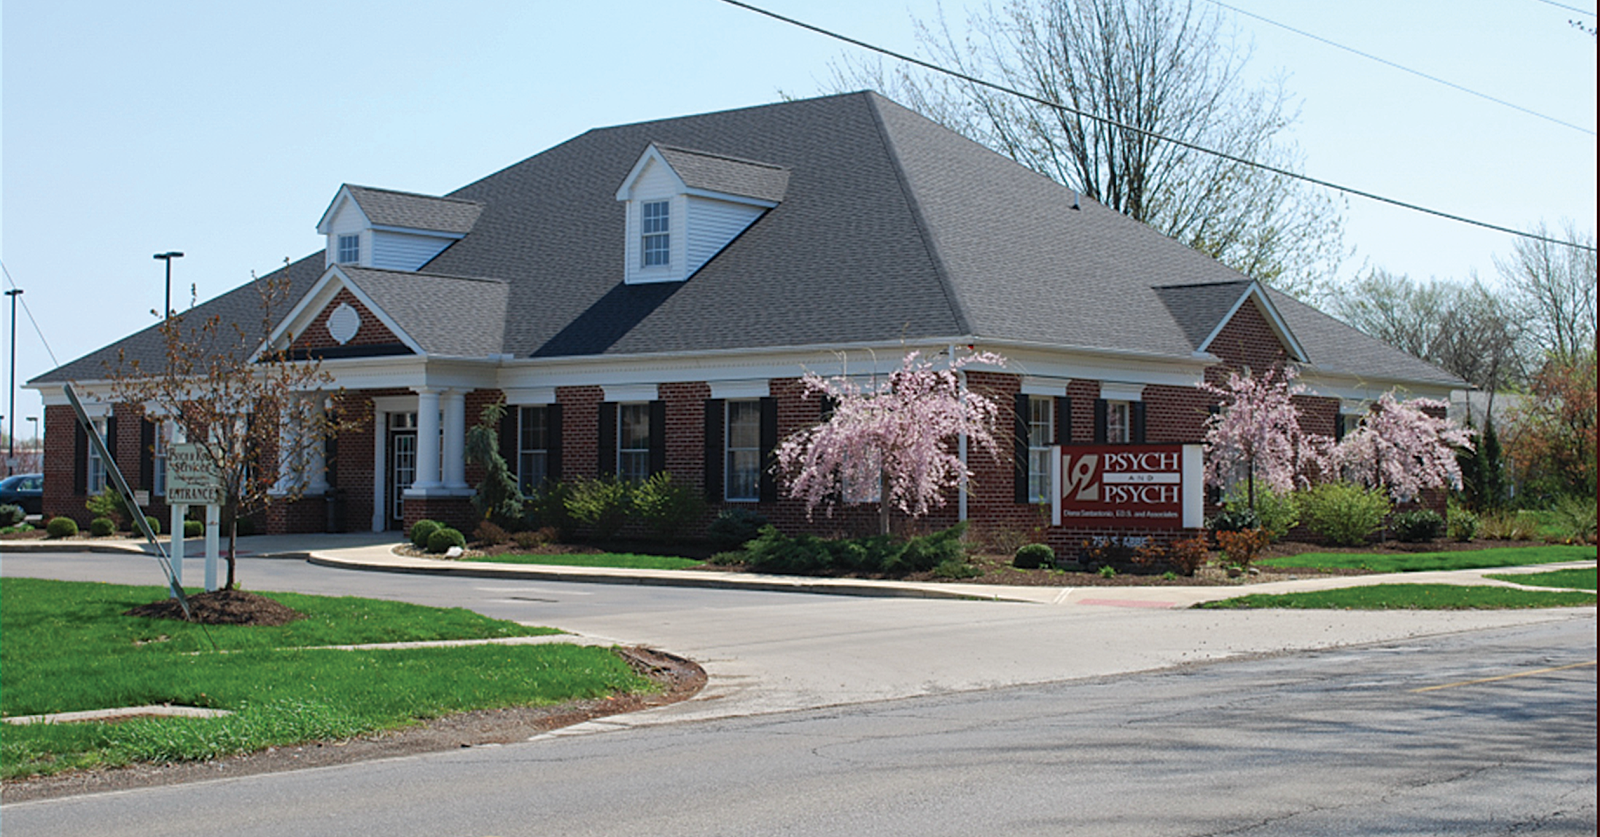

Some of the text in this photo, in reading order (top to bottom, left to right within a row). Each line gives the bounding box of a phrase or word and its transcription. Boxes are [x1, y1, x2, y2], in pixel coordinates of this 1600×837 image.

[1104, 452, 1180, 471] PSYCH
[169, 488, 213, 499] ENTRANCE
[1104, 485, 1180, 504] PSYCH
[1134, 510, 1145, 518] and
[1146, 510, 1179, 519] Associates
